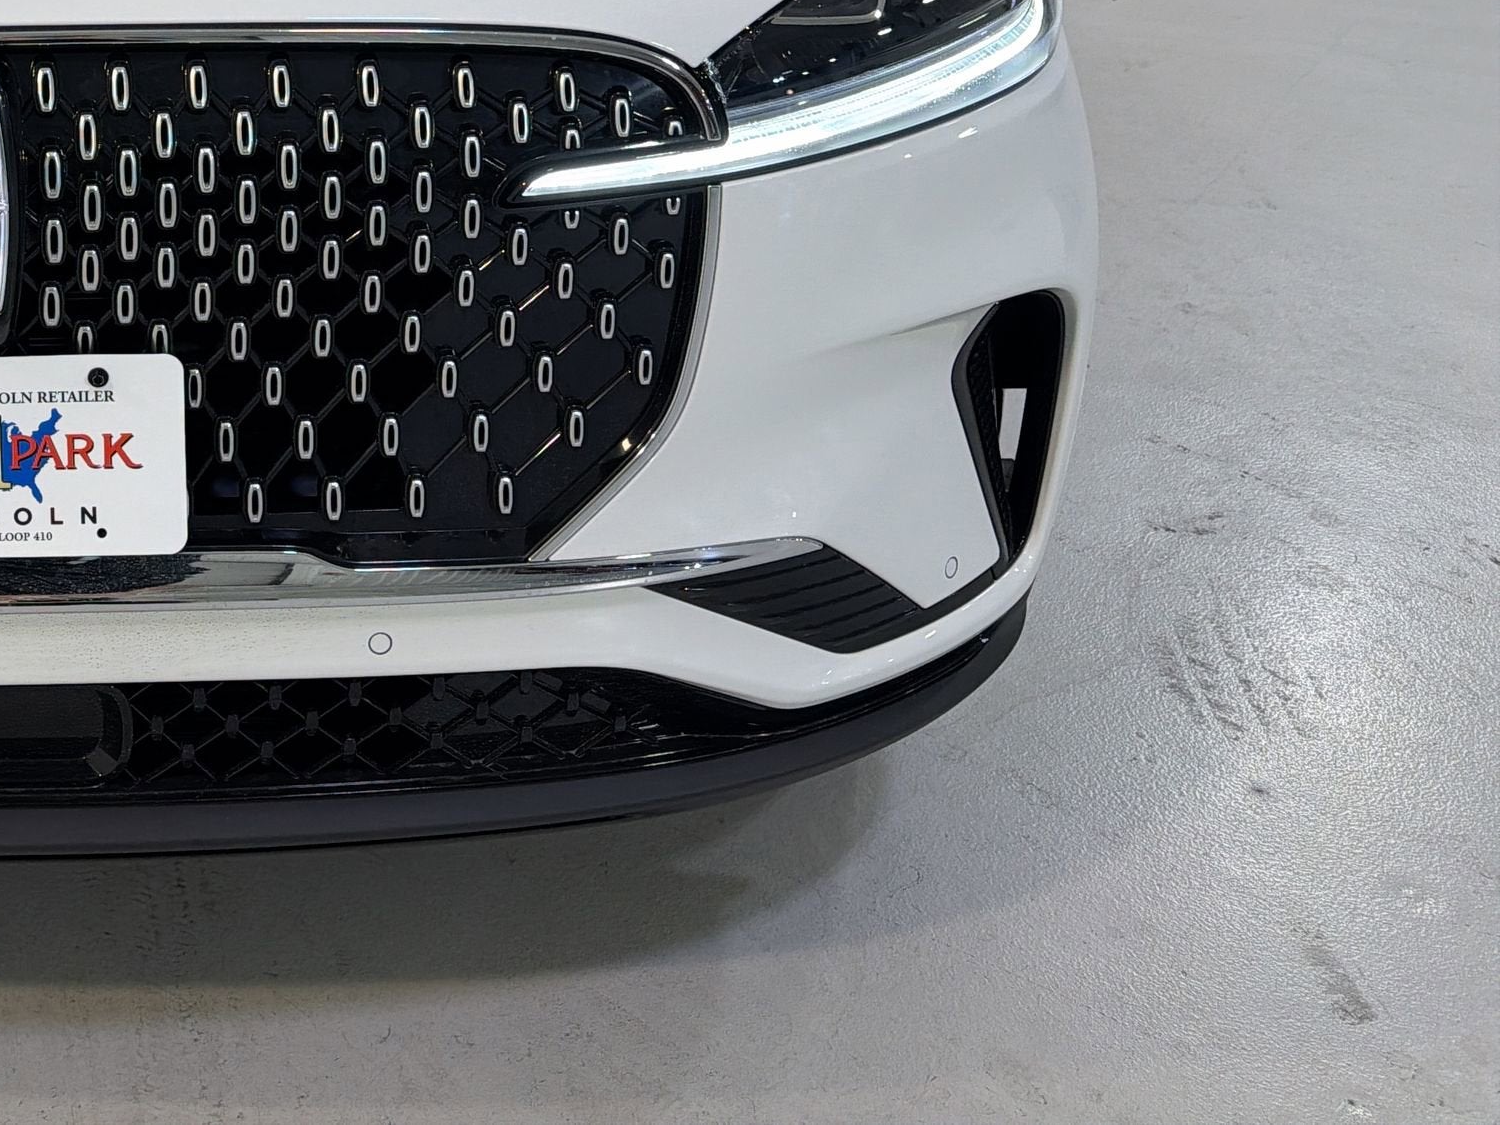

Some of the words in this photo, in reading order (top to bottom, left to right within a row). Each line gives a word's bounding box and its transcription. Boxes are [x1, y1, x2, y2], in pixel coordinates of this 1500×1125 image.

[37, 390, 115, 403] RETAILER
[9, 433, 144, 470] PARK
[33, 531, 53, 542] 410
